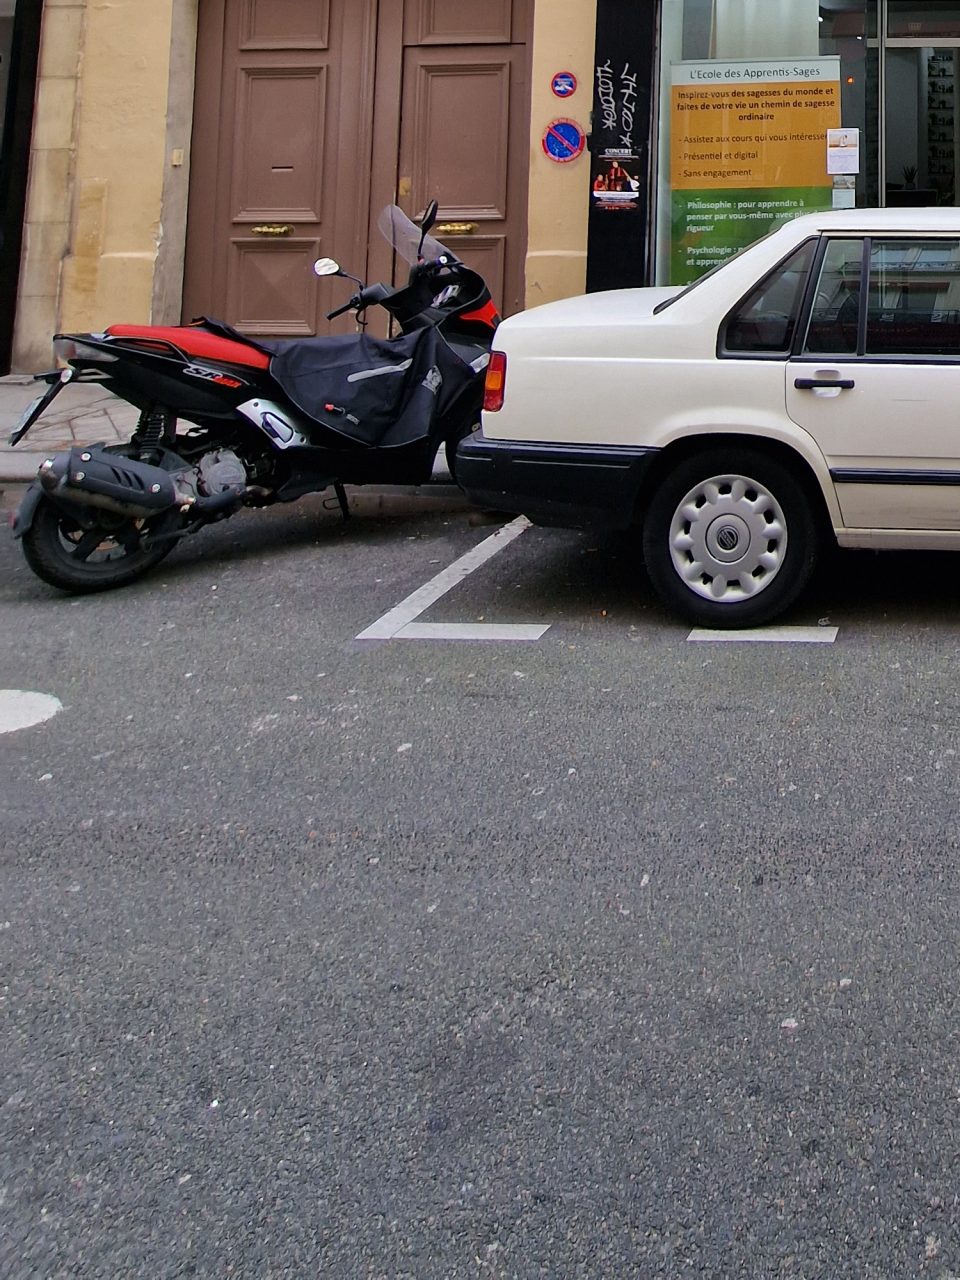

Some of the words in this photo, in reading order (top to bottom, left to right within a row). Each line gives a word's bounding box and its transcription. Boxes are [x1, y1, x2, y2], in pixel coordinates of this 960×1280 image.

[690, 69, 722, 79] L'Ecole
[724, 69, 741, 78] des
[743, 67, 820, 78] Apprentis-Sages
[678, 91, 730, 100] Inspirez-vous
[746, 90, 781, 98] sagesses
[795, 88, 824, 96] monde
[677, 103, 698, 111] faites
[700, 102, 711, 110] de
[804, 100, 835, 108] sagesse
[738, 113, 775, 121] ordinaire
[754, 134, 767, 143] qui
[683, 152, 722, 160] Présentiel
[734, 151, 758, 160] digital
[703, 169, 752, 178] engagement
[687, 201, 732, 209] Philosophie
[737, 202, 756, 210] pour
[757, 200, 798, 209] apprendre
[799, 199, 804, 207] à
[686, 213, 712, 221] penser
[728, 211, 774, 219] vous-même
[687, 224, 714, 232] rigueur
[687, 246, 732, 255] Psychologie
[686, 258, 695, 266] et
